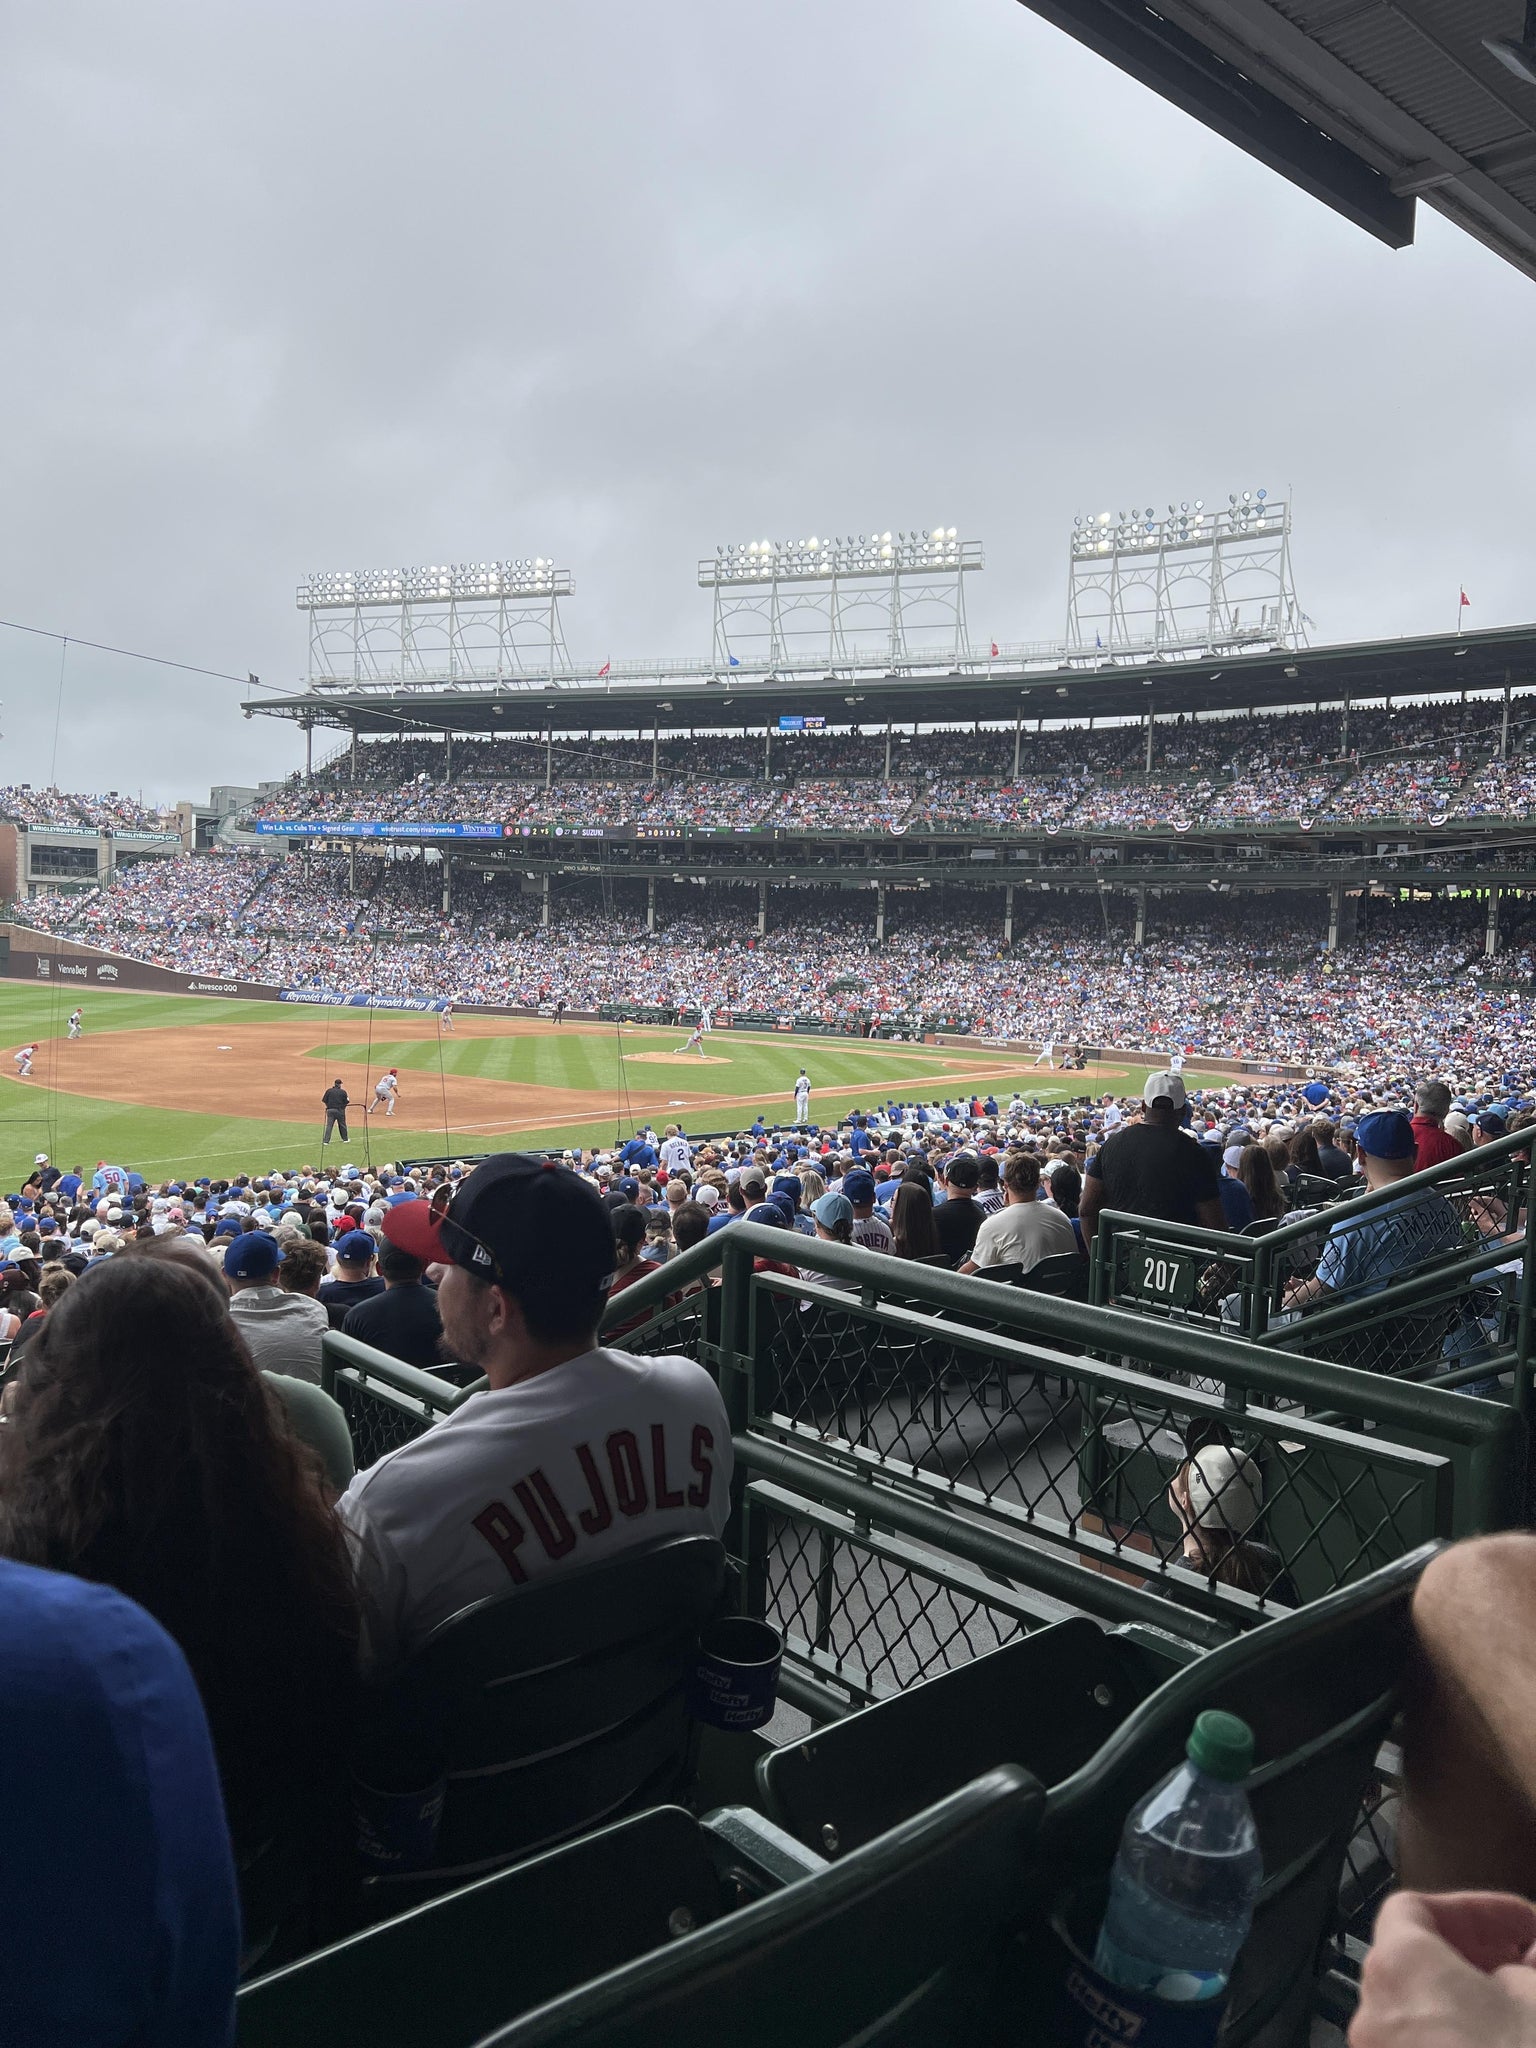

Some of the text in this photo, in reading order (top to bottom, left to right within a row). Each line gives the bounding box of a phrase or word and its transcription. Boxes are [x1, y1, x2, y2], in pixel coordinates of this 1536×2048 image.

[32, 824, 97, 836] WRIGLEYROOFTOPS.COM
[293, 824, 307, 832] Cubs
[321, 825, 340, 833] Signed
[380, 825, 456, 835] wintrust.com/rivalryseries
[462, 824, 498, 832] WINTRUST
[581, 828, 604, 836] SUZUKI
[58, 963, 75, 975] Vienna
[75, 964, 88, 978] Beef
[96, 964, 119, 978] MARQUEE
[198, 982, 238, 992] Invesco QQQ
[285, 991, 342, 1005] Reynolds Wrap
[366, 996, 426, 1010] Reynolds Wrap
[677, 1148, 685, 1161] 2
[104, 1171, 120, 1184] 50
[1143, 1257, 1180, 1294] 207
[471, 1423, 715, 1585] PUJOLS
